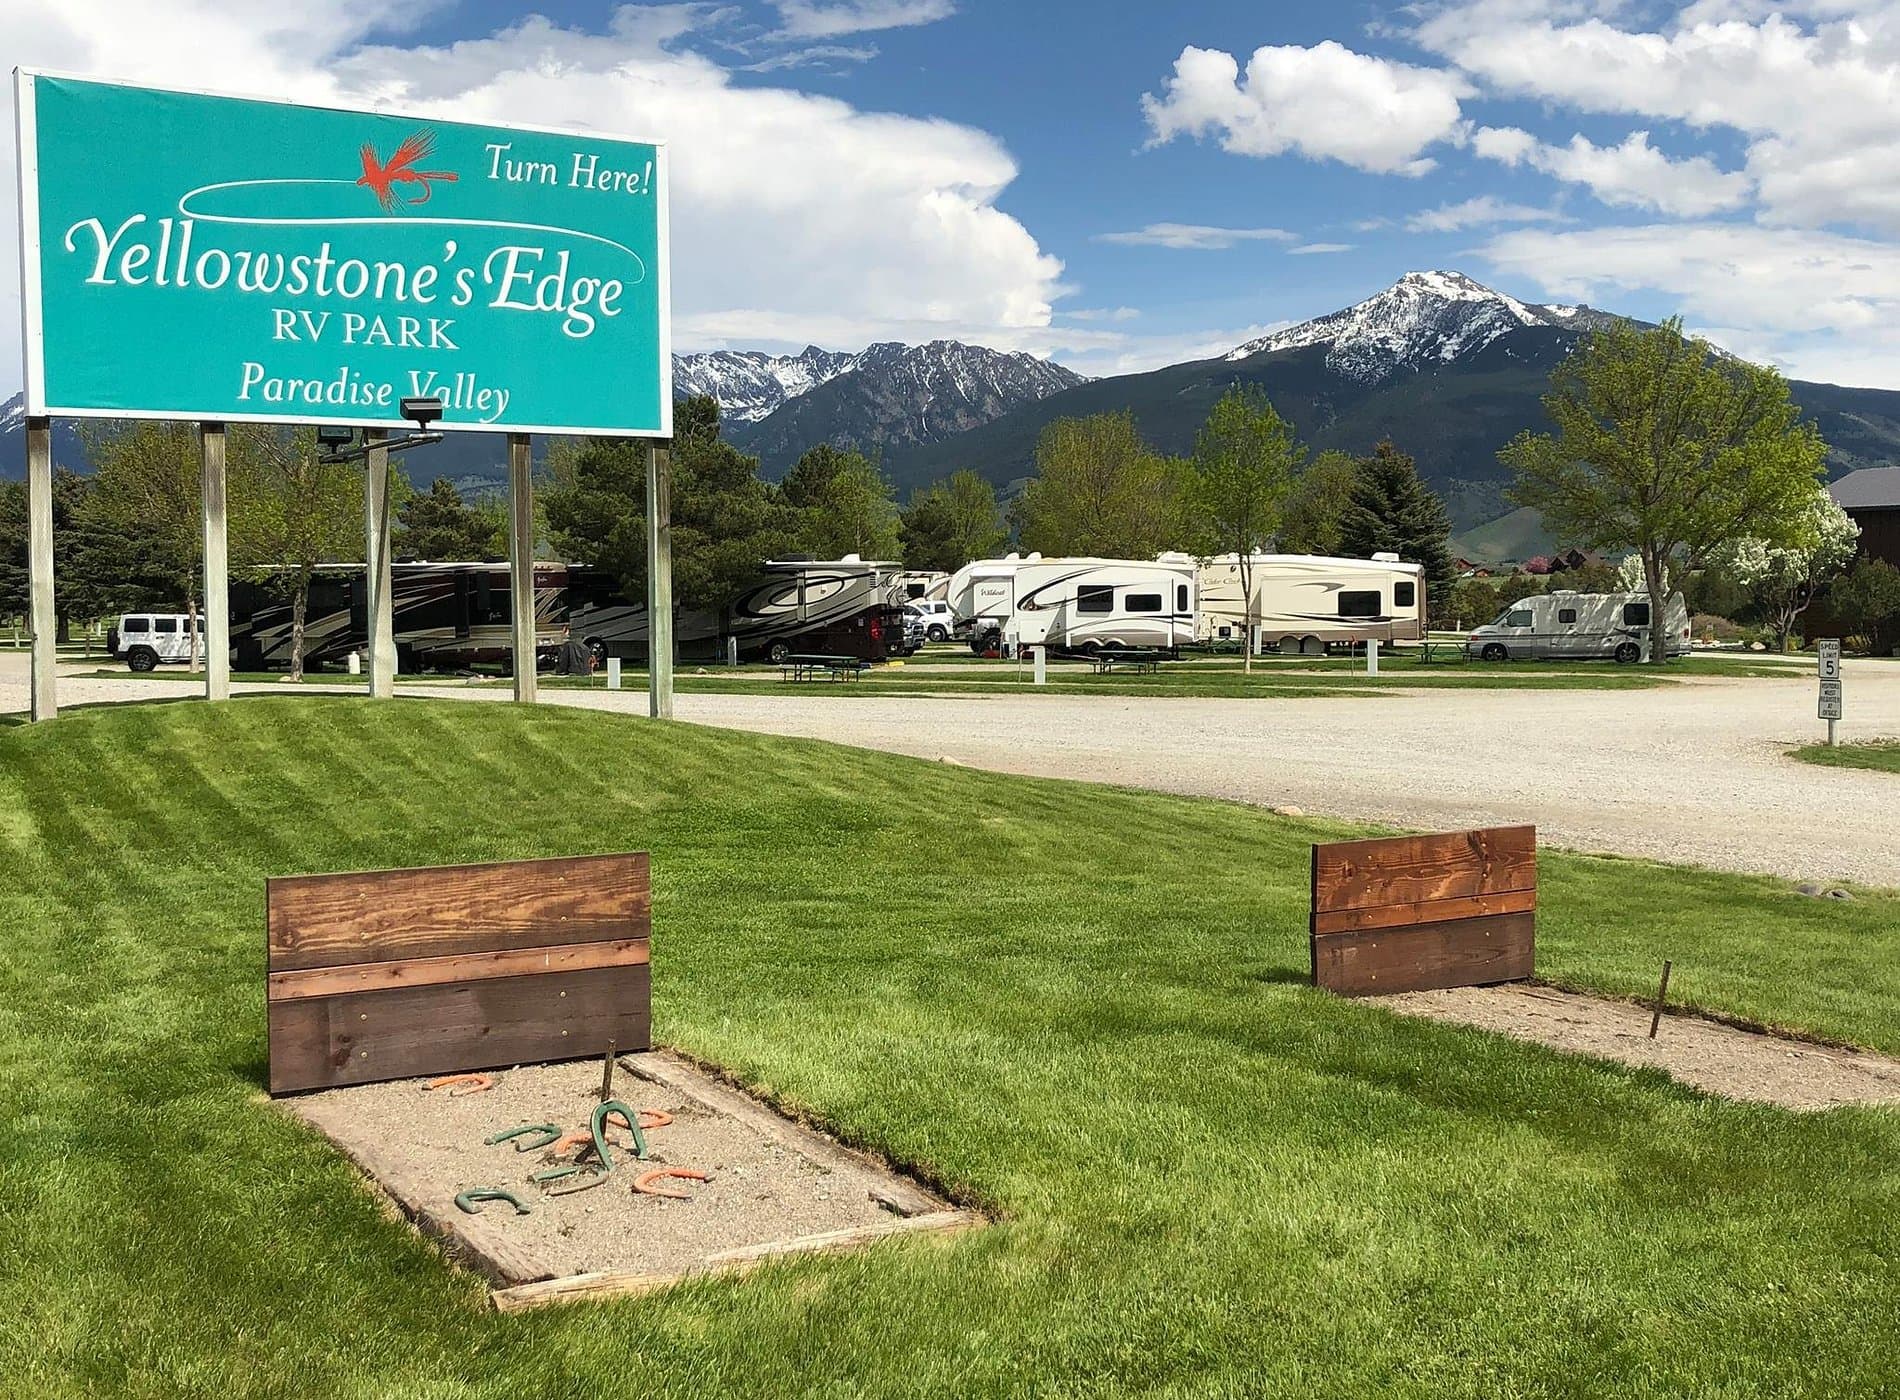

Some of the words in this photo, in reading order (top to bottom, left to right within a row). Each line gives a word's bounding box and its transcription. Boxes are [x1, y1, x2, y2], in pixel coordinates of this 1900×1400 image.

[486, 142, 558, 185] Turn
[567, 153, 653, 197] Here!
[65, 213, 475, 307] Yellowstone's
[484, 246, 623, 338] Edge
[272, 309, 331, 343] RV
[344, 313, 459, 350] PARK
[238, 362, 393, 406] Paradise
[407, 370, 510, 424] Valley
[1826, 660, 1835, 675] 5
